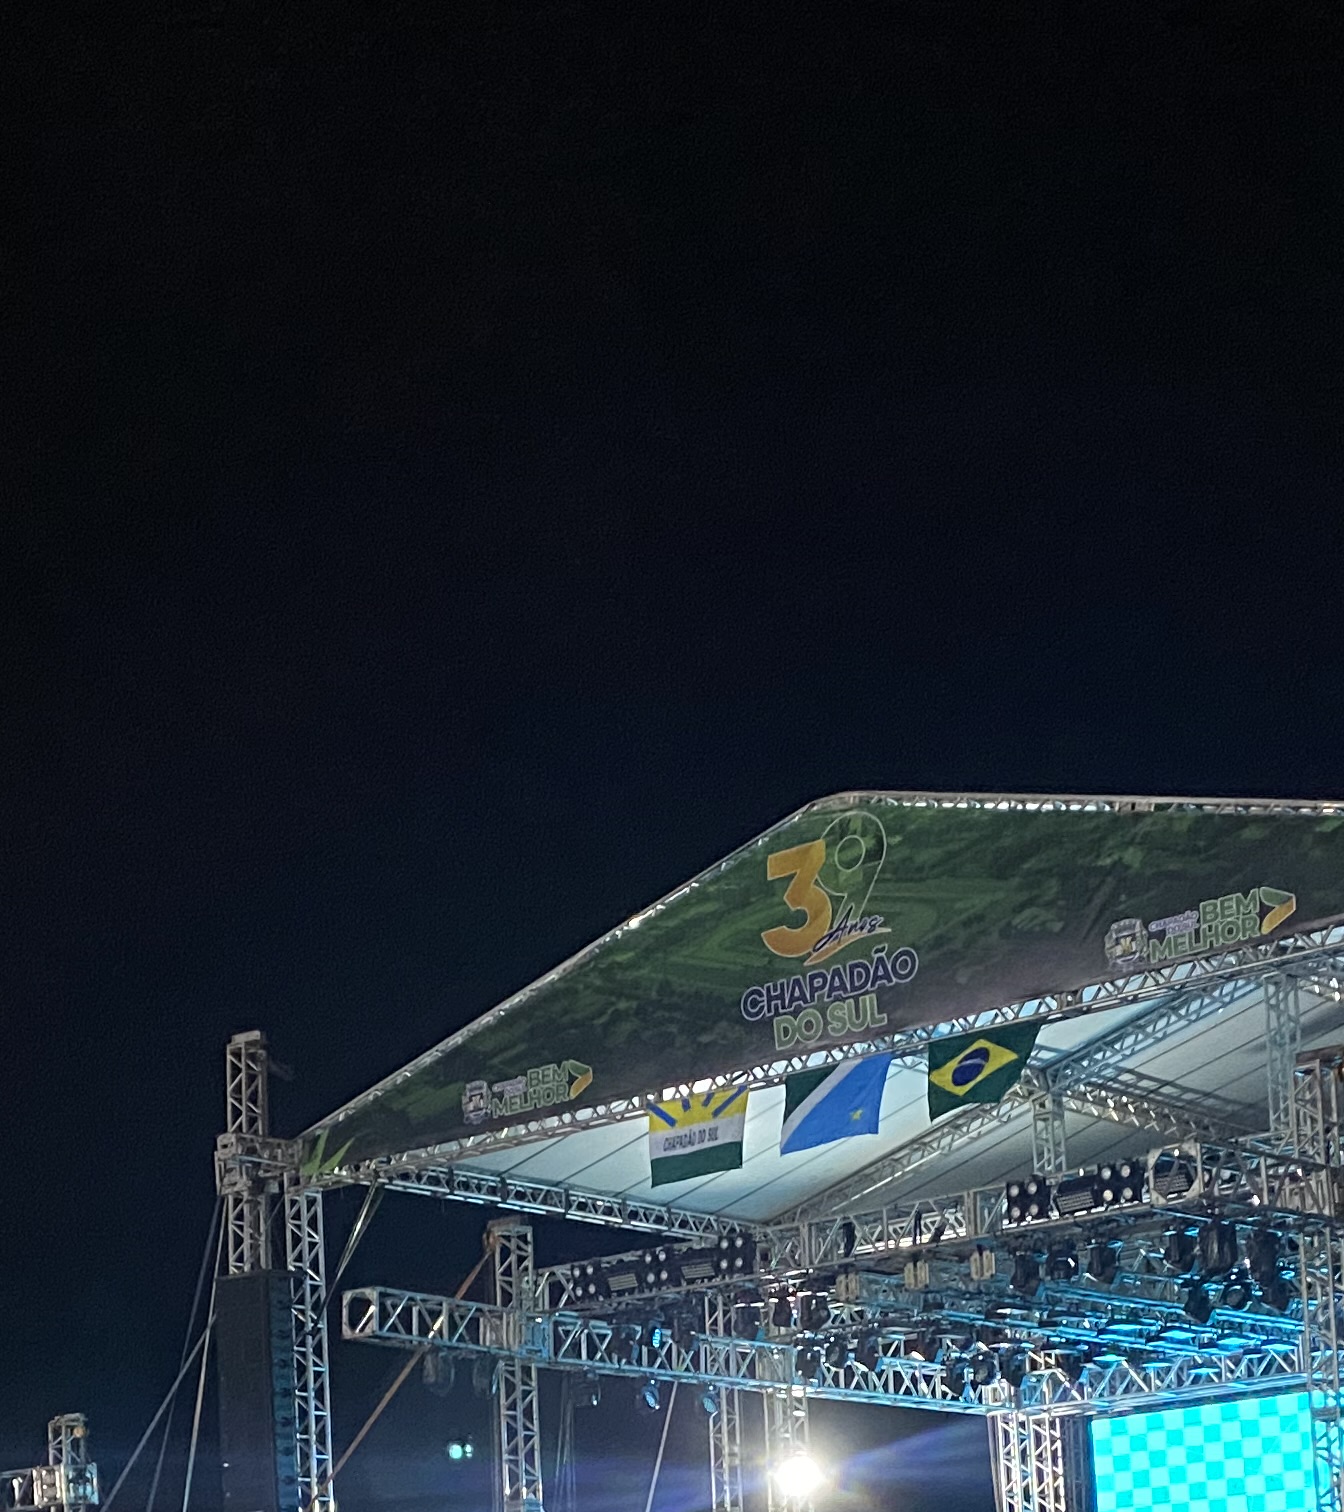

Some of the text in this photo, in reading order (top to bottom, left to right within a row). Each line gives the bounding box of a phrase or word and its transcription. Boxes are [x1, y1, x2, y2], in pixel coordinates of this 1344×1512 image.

[761, 810, 886, 957] 39
[1200, 889, 1259, 926] BEM
[812, 903, 883, 953] Anos
[1149, 914, 1260, 963] MELHOR
[741, 944, 918, 1021] CHAPADÃO
[773, 994, 887, 1050] DO SUL
[492, 1082, 569, 1119] MELHOR
[527, 1064, 568, 1090] BEM
